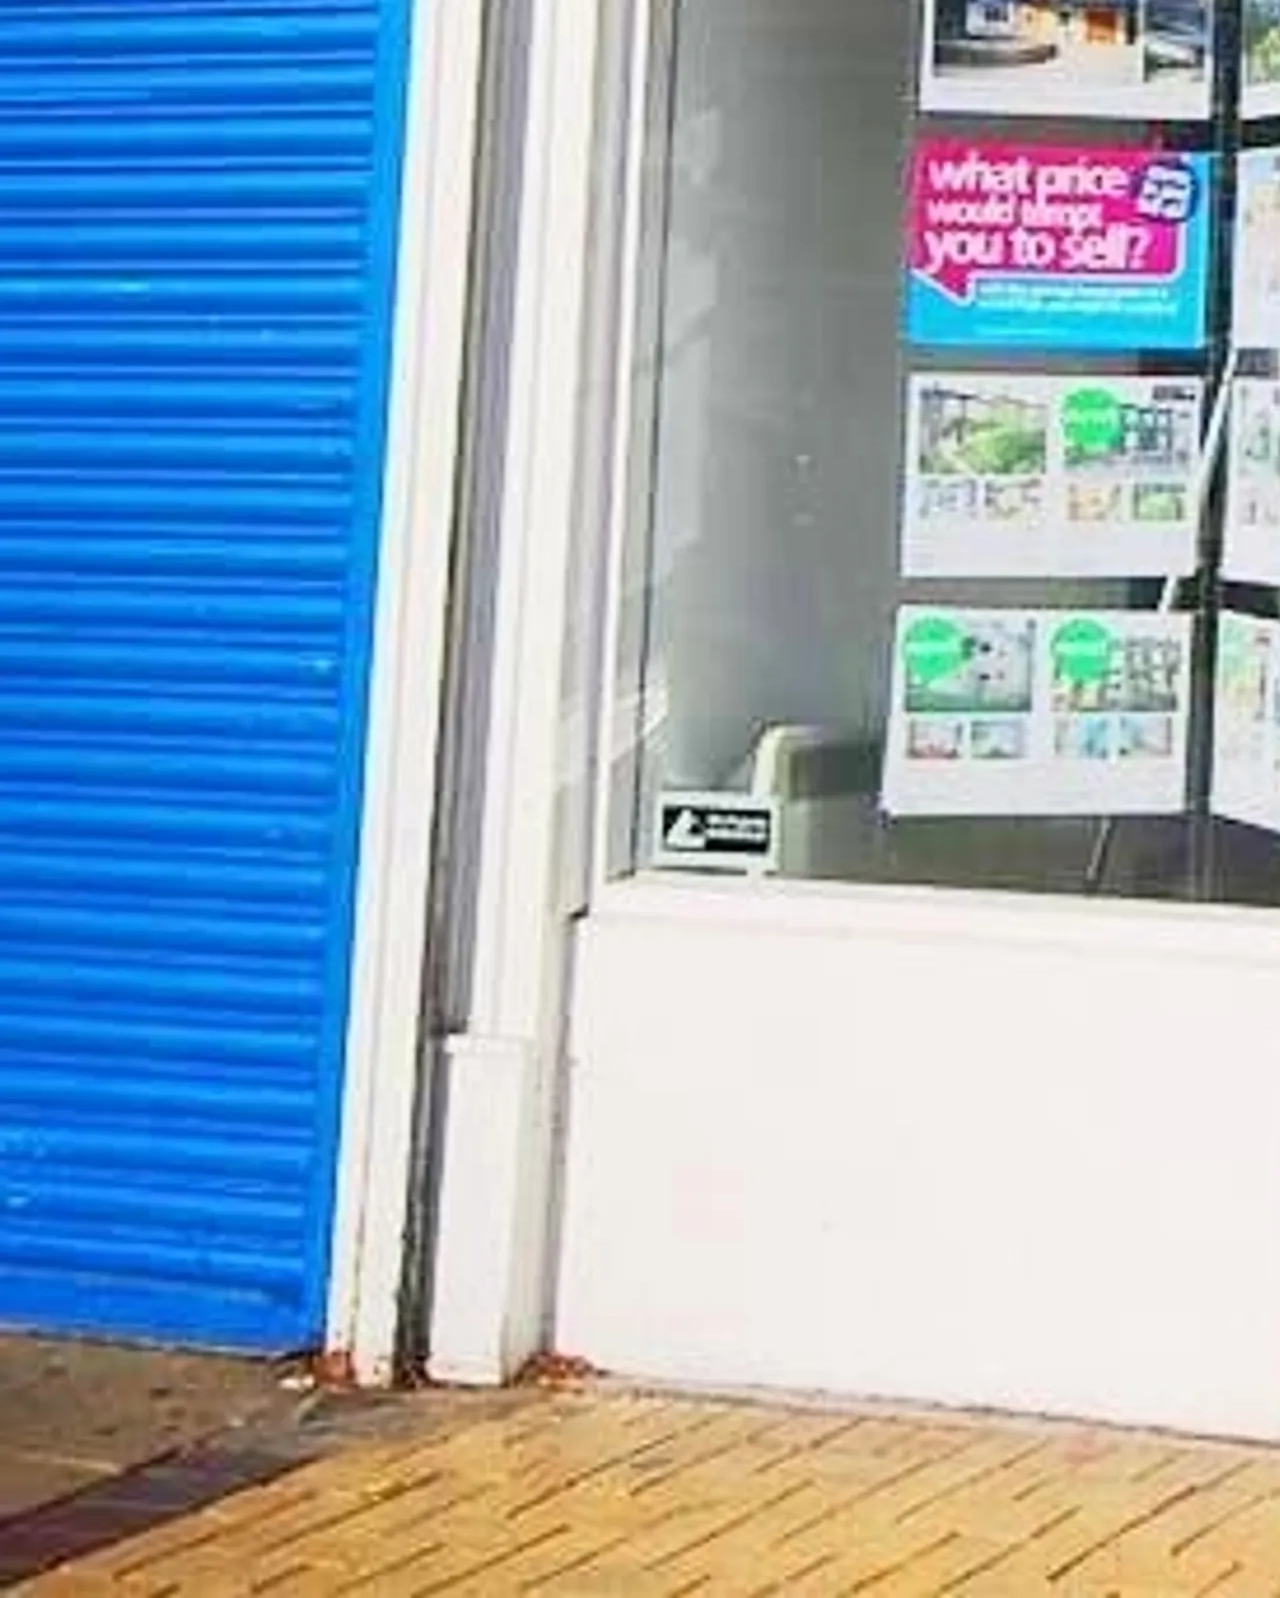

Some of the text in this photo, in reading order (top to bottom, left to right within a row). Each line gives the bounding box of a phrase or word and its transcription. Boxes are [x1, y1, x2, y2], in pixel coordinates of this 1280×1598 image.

[929, 154, 1029, 193] what
[1036, 155, 1128, 205] price
[926, 196, 1014, 224] would
[924, 222, 1153, 274] you to sell?
